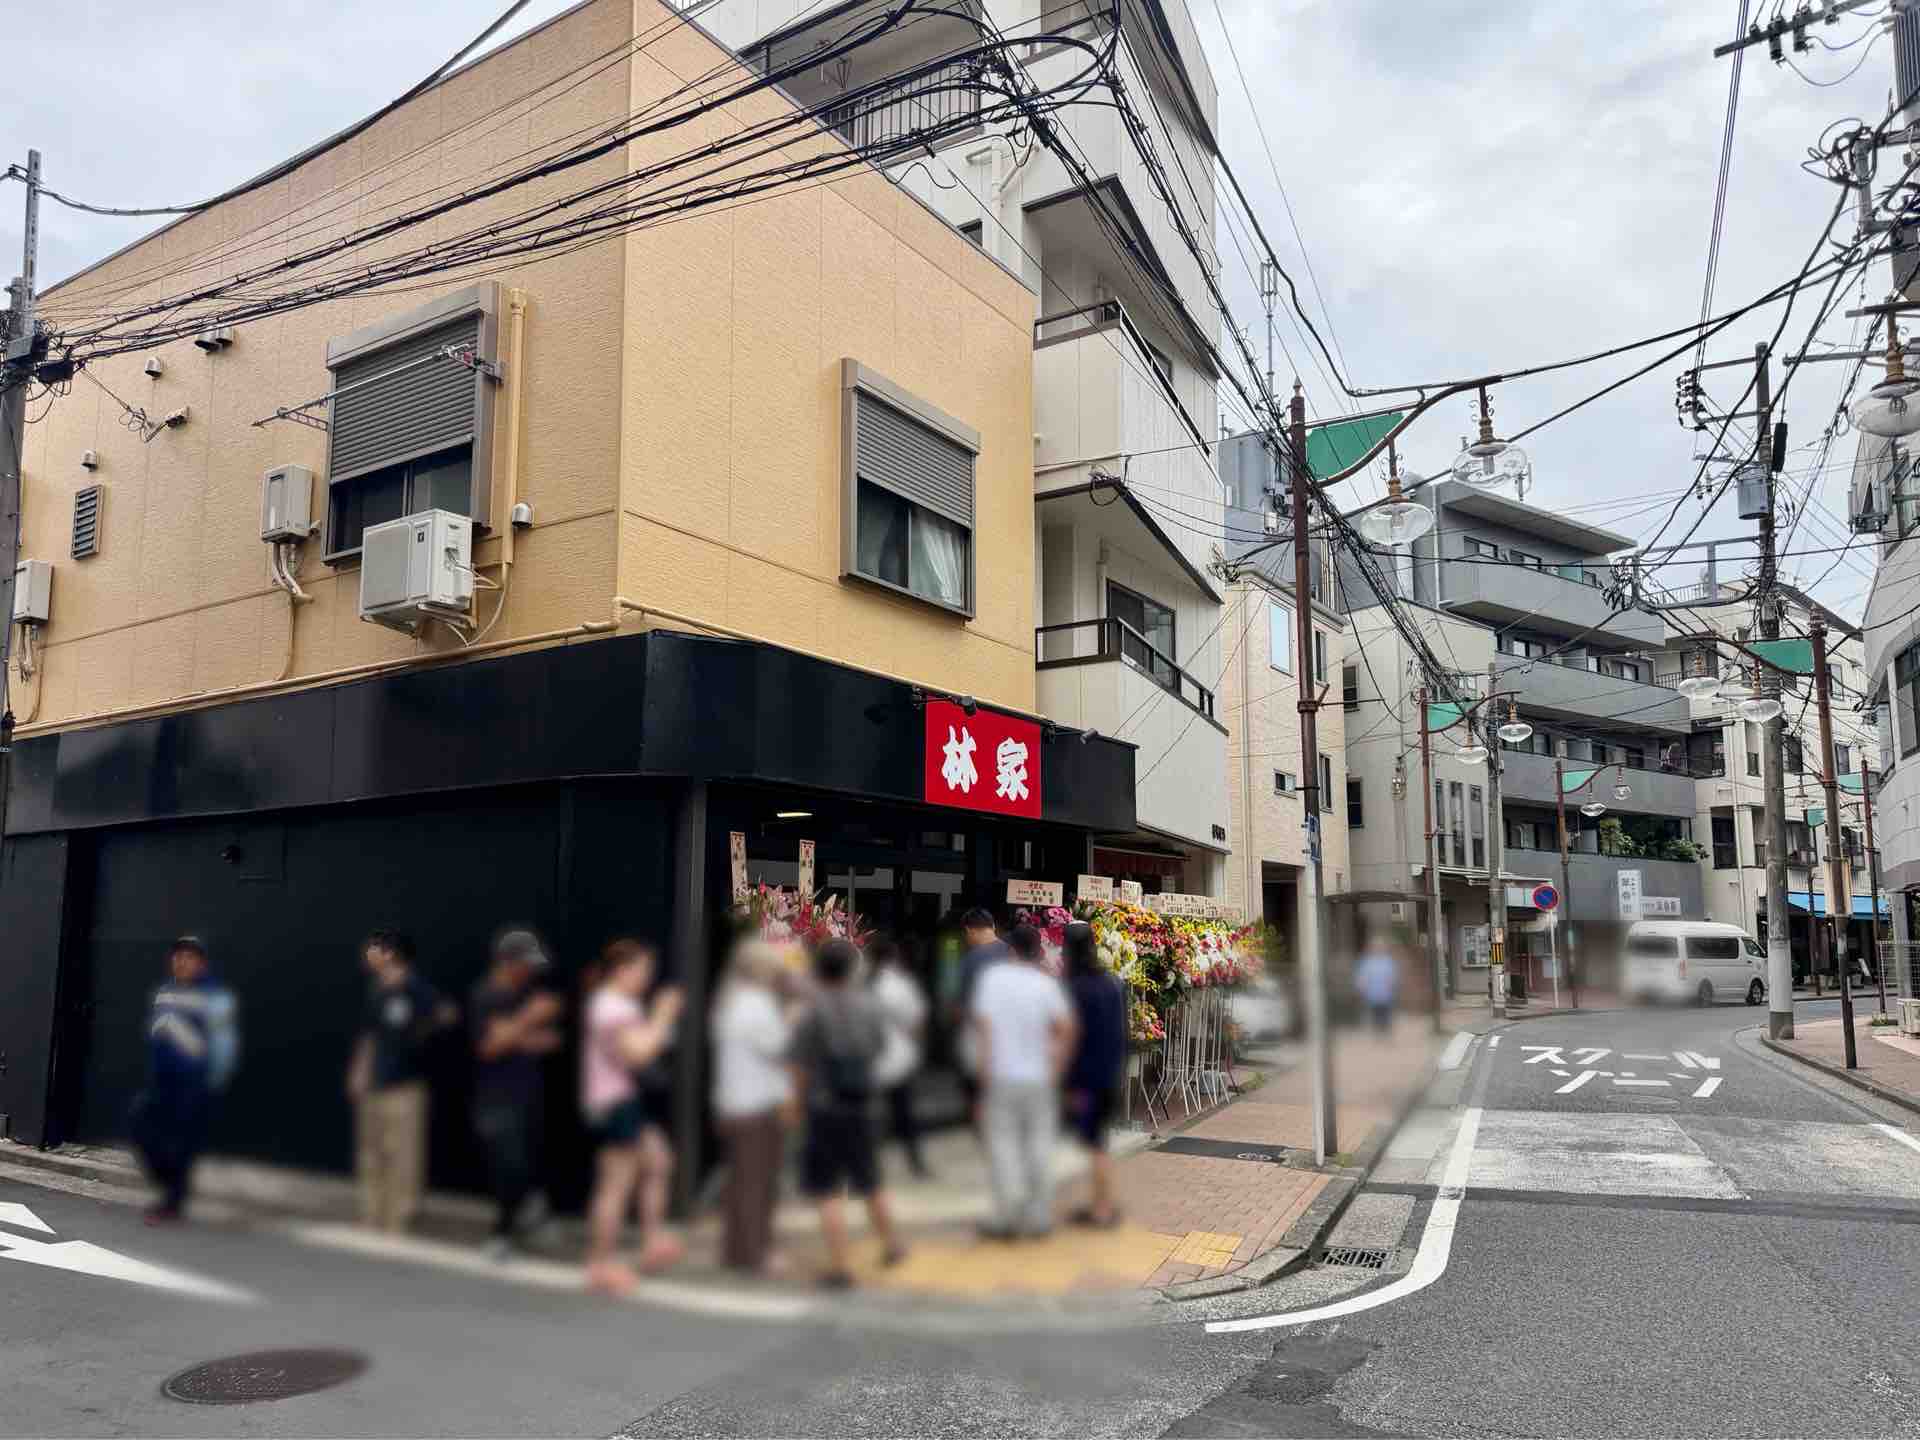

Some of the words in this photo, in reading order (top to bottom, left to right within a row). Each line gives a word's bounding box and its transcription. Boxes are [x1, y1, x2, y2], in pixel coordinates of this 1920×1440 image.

[942, 725, 1029, 801] 林家
[1520, 1045, 1721, 1070] スクール
[1547, 1069, 1724, 1098] ゾーン
